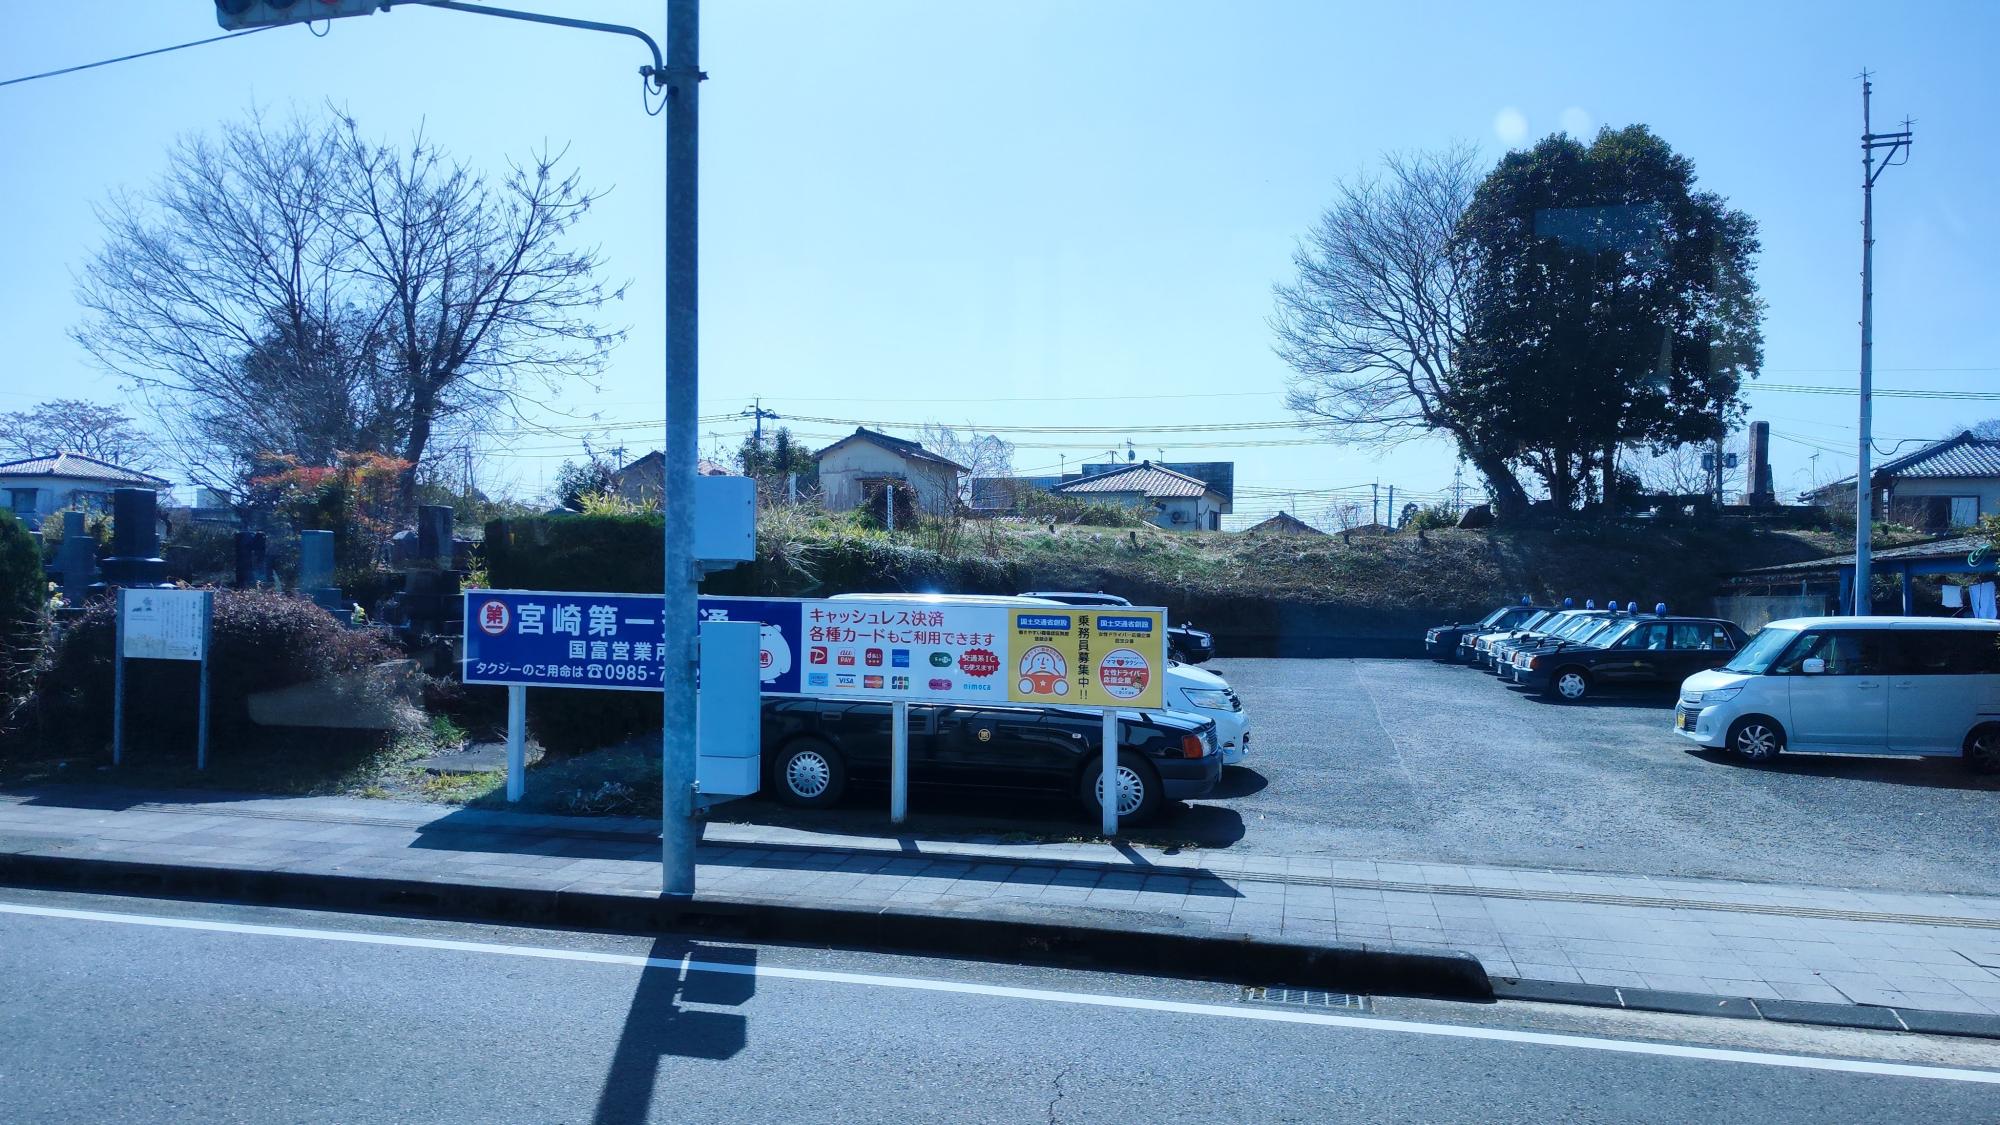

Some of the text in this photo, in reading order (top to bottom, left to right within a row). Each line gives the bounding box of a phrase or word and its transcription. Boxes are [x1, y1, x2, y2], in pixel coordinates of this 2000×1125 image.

[809, 607, 945, 628] キャッシュレス決済
[809, 626, 996, 647] 各種カードもご利用できます
[476, 661, 584, 678] タクシーのご用命は
[963, 683, 991, 691] nimoca
